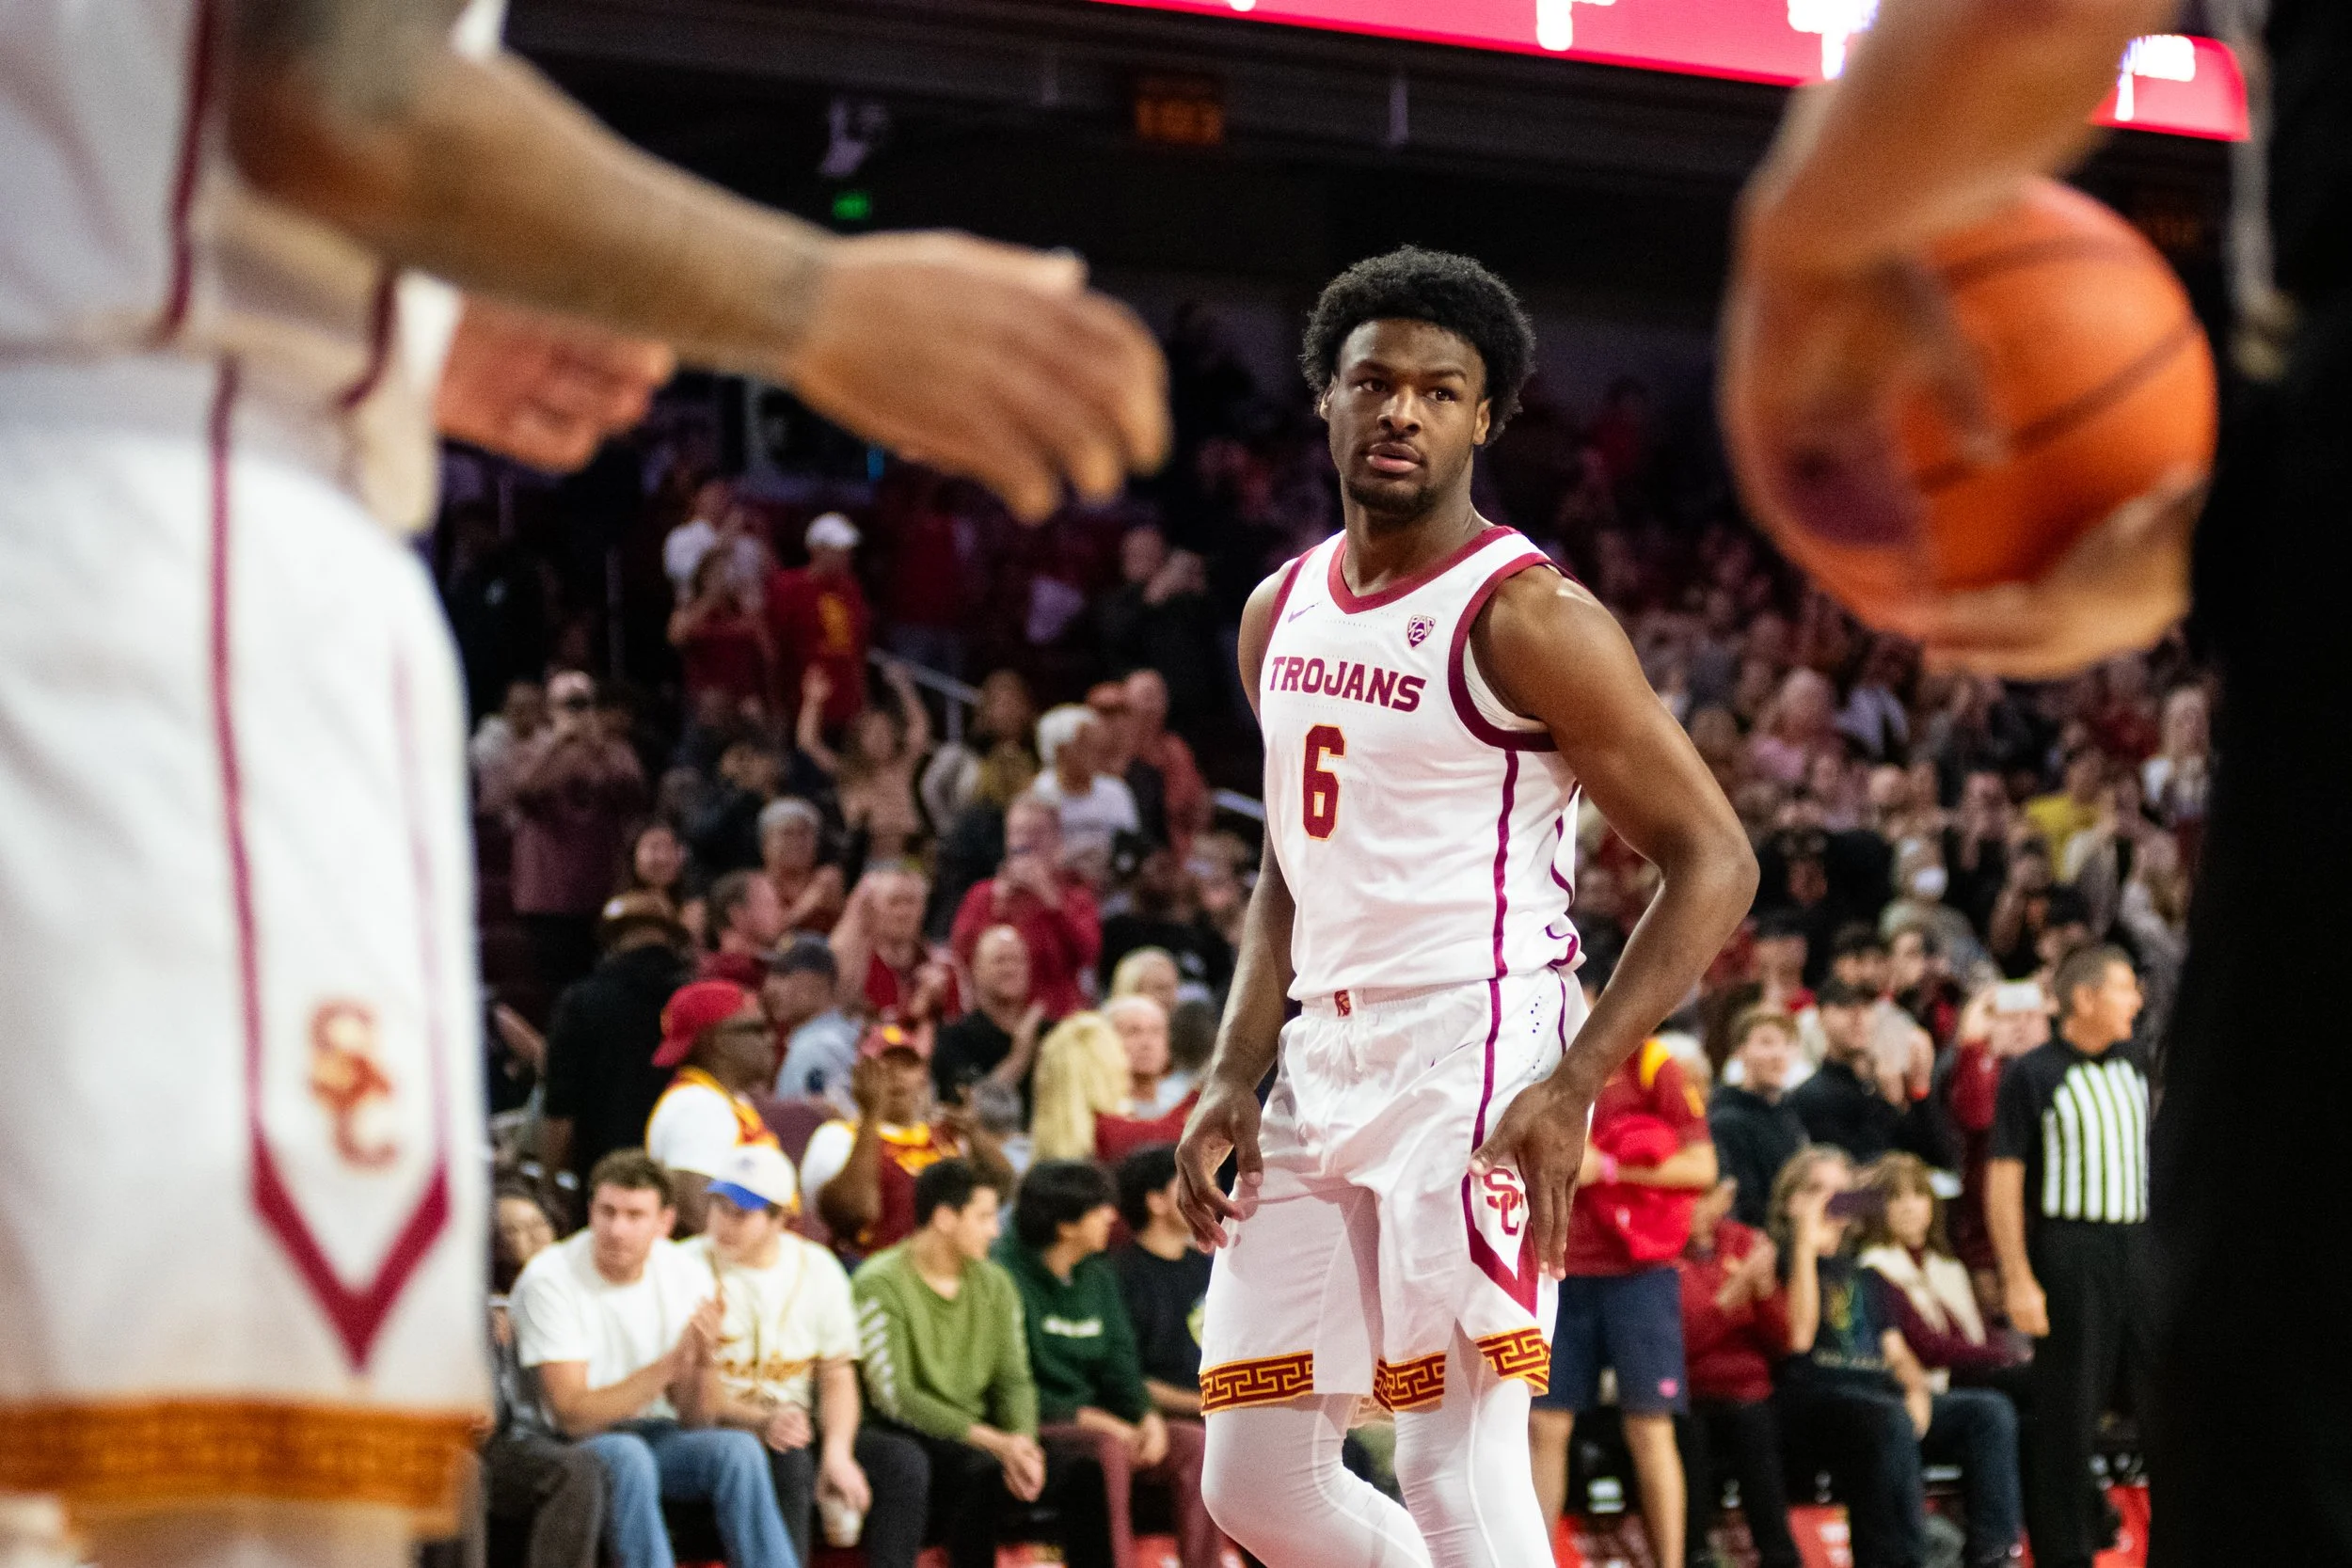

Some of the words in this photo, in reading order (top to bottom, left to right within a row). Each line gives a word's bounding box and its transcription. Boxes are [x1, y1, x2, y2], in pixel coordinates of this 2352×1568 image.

[1409, 628, 1426, 641] 12
[1269, 656, 1427, 713] TROJANS
[1302, 722, 1347, 842] 6
[307, 998, 403, 1172] SC
